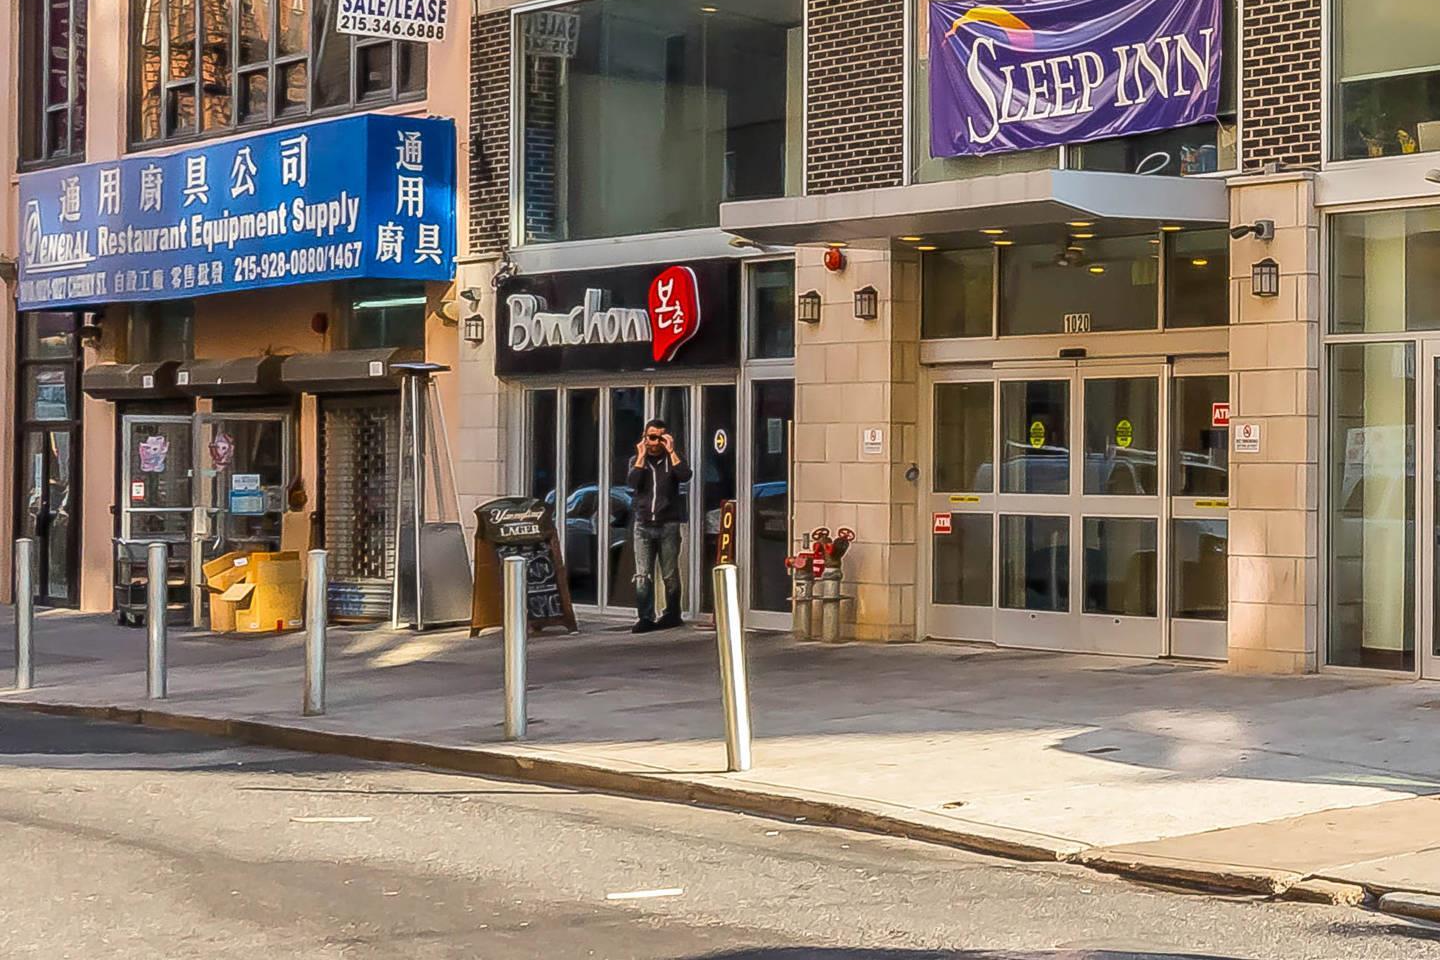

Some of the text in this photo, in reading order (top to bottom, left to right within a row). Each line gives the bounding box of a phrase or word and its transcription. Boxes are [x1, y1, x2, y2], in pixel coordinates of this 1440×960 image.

[340, 14, 445, 40] 215.346.6888
[966, 27, 1215, 143] SLEEP INN
[395, 130, 424, 218] 通用
[97, 217, 188, 257] Restaurant
[191, 201, 288, 253] Equipment
[292, 190, 360, 237] Supply
[233, 241, 363, 283] 215-928-0880/1467
[1065, 314, 1090, 333] 1020
[500, 524, 541, 537] LAGER
